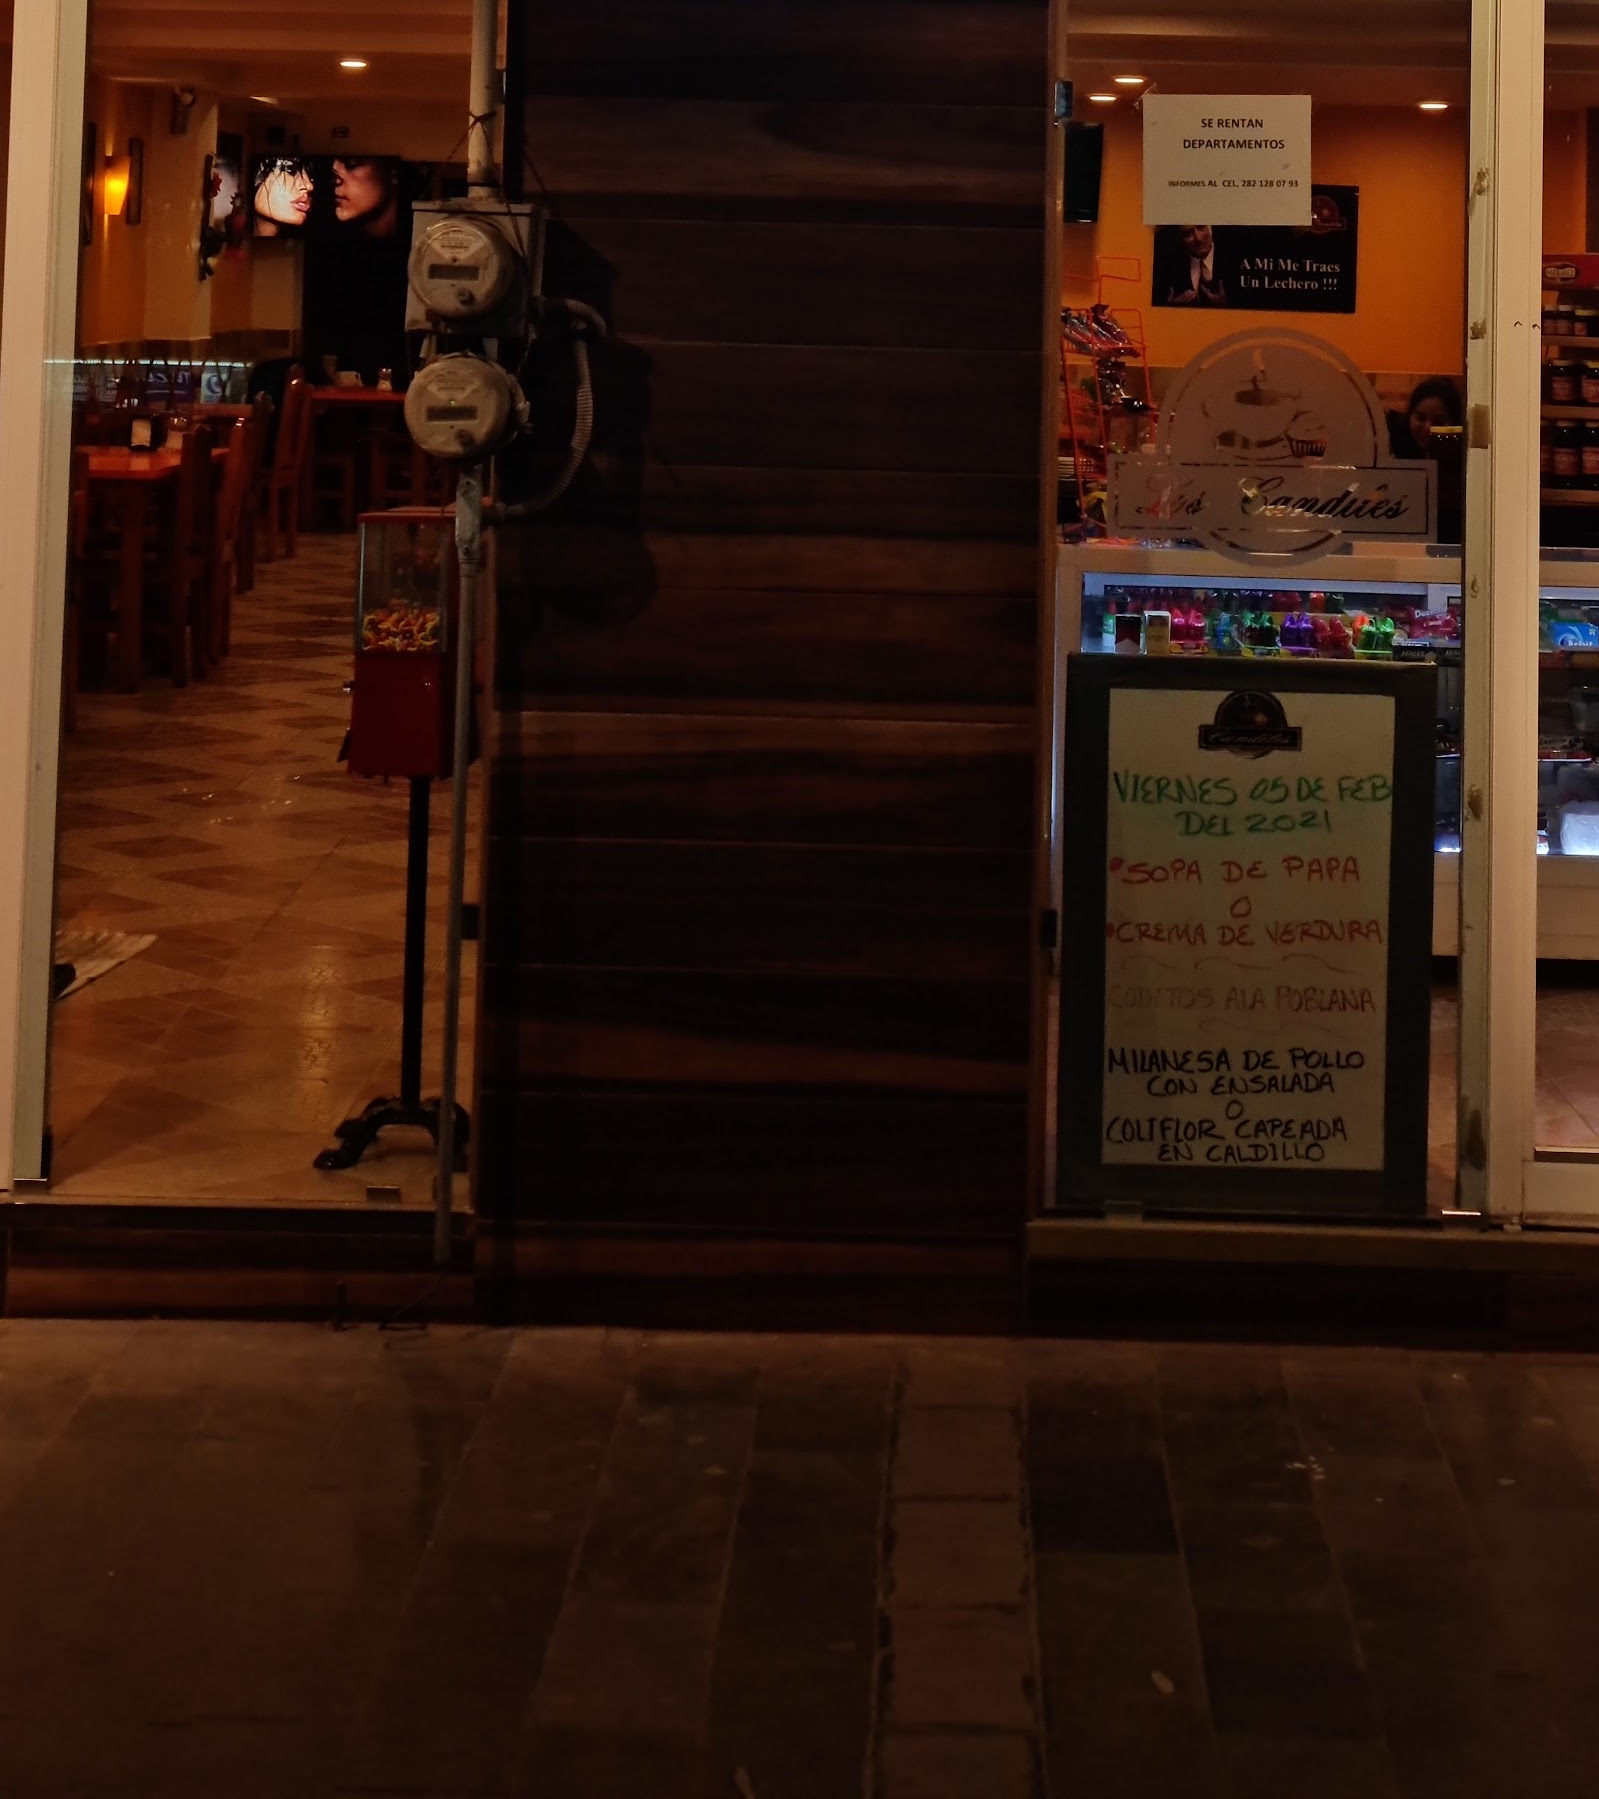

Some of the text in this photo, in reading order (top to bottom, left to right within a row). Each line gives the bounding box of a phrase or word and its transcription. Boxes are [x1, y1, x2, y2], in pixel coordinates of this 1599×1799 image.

[1201, 118, 1264, 128] SE RENTAN
[1183, 138, 1285, 149] DEPARTAMENTOS
[1168, 180, 1206, 188] INFORMES
[1207, 180, 1218, 188] AL
[1242, 179, 1256, 188] 282
[1259, 179, 1275, 188] 128
[1276, 179, 1287, 188] 07
[1288, 179, 1299, 188] 93
[1239, 257, 1341, 273] A Mi Me Traes
[1240, 275, 1260, 288] Un
[1263, 275, 1319, 290] Lechero
[1113, 769, 1393, 805] VIERNES 05 DE FEB
[1175, 809, 1333, 836] DEL 2021
[1120, 855, 1360, 884] SOPA DE PAPA
[1115, 919, 1383, 946] CREMA DE VERDURA
[1108, 1047, 1365, 1075] MILANESA DE POLLO
[1147, 1072, 1335, 1097] CON ENSALADA
[1106, 1116, 1348, 1144] COLIFLOR CAPEADA
[1157, 1141, 1325, 1164] EN CALDILLO
